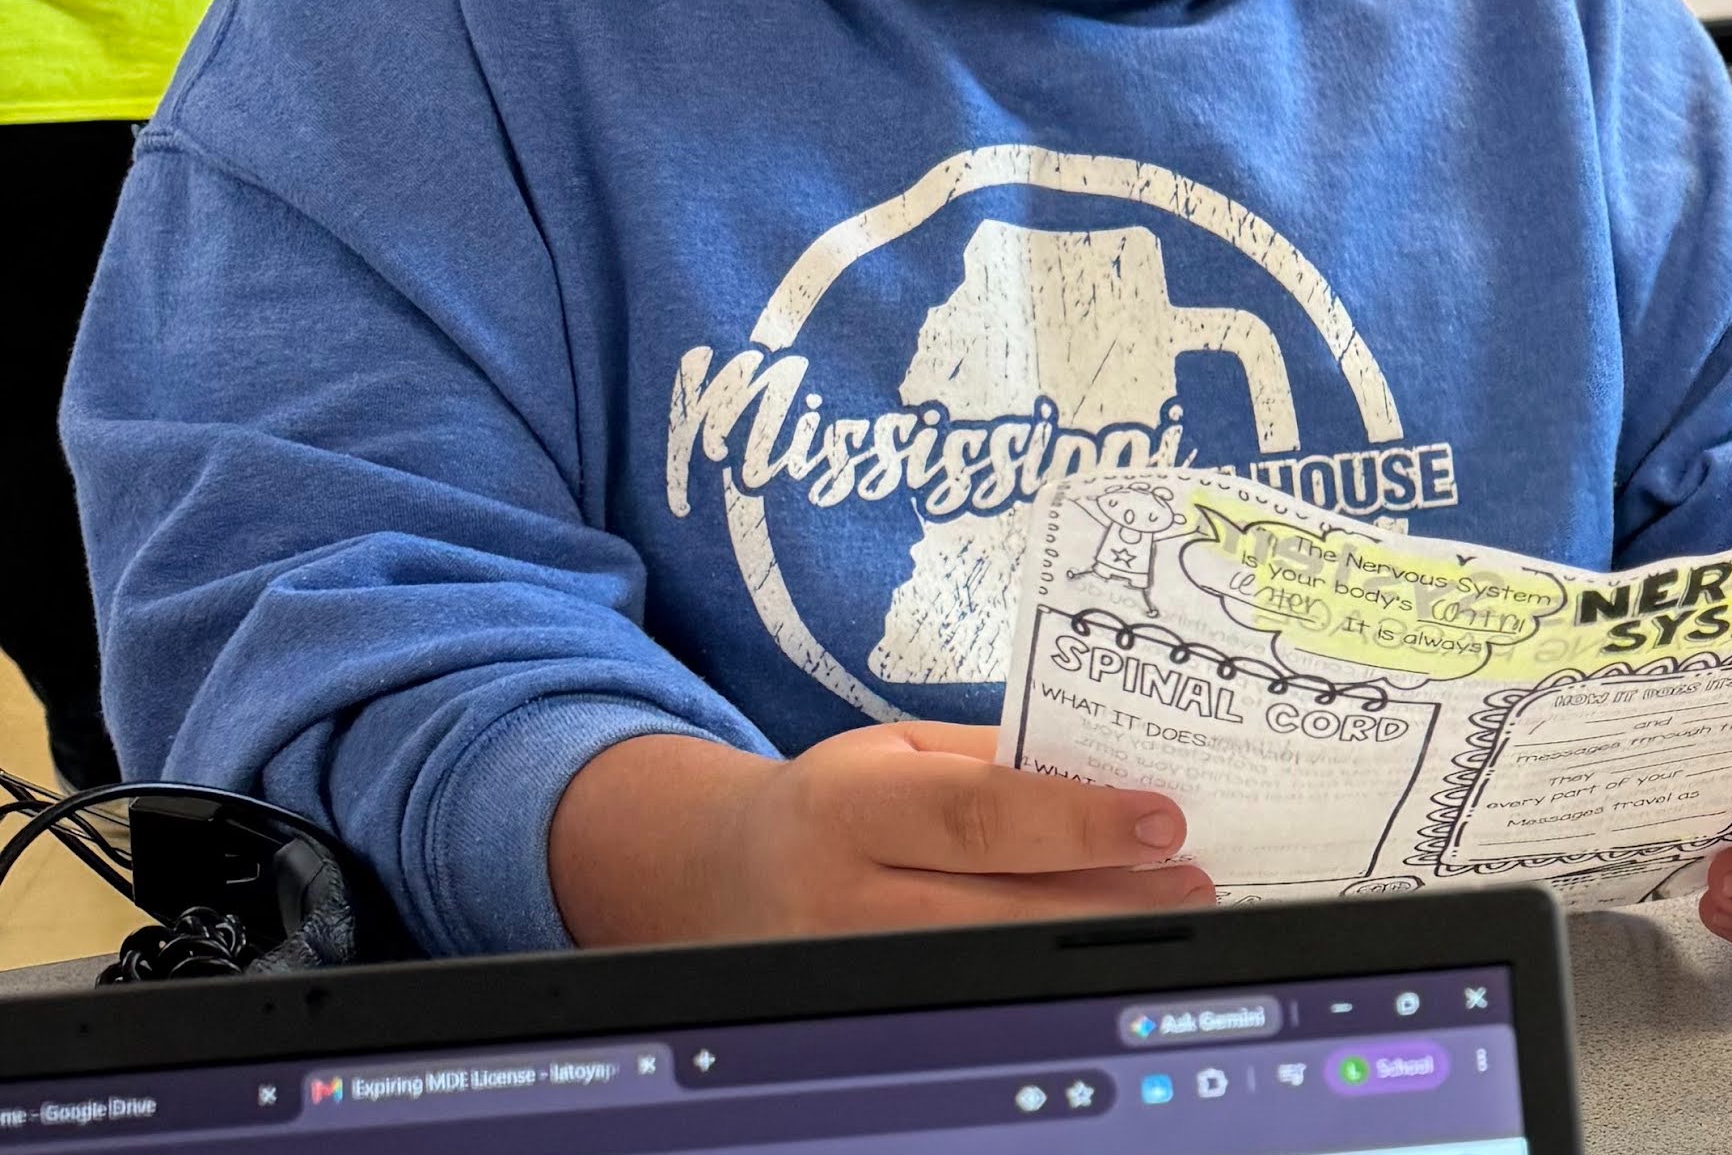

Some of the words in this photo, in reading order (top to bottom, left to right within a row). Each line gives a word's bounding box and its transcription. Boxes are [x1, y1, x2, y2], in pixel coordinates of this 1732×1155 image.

[1268, 561, 1327, 591] your
[1334, 580, 1413, 614] body's
[1296, 536, 1338, 563] The
[1346, 552, 1448, 589] Nervous
[1457, 577, 1552, 608] System
[1342, 616, 1371, 634] It
[1377, 624, 1395, 642] is
[1402, 630, 1484, 656] always
[1042, 683, 1106, 717] WHAT
[1112, 709, 1140, 730] IT
[1051, 635, 1244, 724] SPINAL
[1265, 703, 1410, 743] CORD
[1634, 716, 1672, 730] and
[1515, 739, 1621, 764] messages
[1629, 724, 1712, 747] through
[1486, 795, 1543, 811] every
[1551, 783, 1598, 802] part
[1606, 777, 1631, 790] of
[1636, 769, 1684, 785] your
[1548, 772, 1594, 787] They
[1506, 803, 1604, 828] Messages
[1612, 792, 1675, 810] travel
[1680, 789, 1700, 799] as
[1160, 1014, 1198, 1034] Ask
[1200, 1006, 1266, 1031] Gemini
[353, 1076, 424, 1100] Expiring
[427, 1073, 469, 1091] MDE
[471, 1068, 536, 1090] License
[1376, 1055, 1435, 1079] School
[42, 1098, 108, 1125] Google
[109, 1095, 157, 1119] Drive
